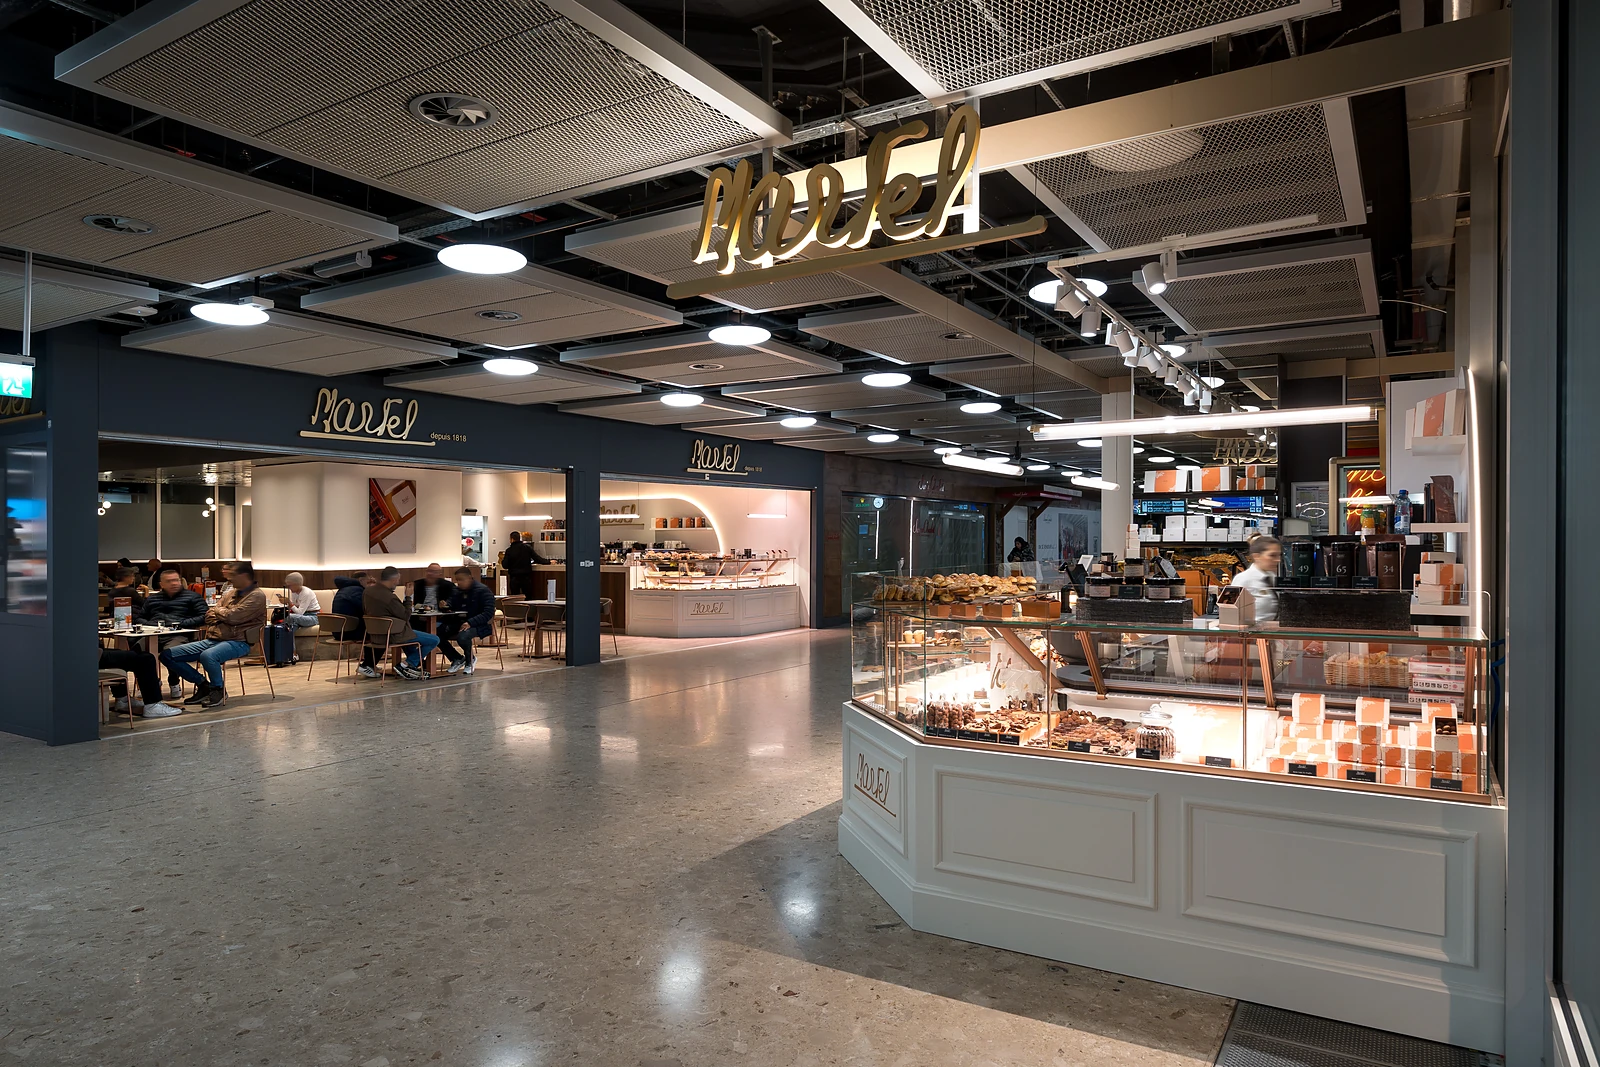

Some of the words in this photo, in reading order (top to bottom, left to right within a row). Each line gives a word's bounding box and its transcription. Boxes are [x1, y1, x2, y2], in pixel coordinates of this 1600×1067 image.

[691, 104, 982, 275] Martel
[311, 387, 419, 440] Martel
[430, 431, 451, 442] depuis
[452, 433, 467, 443] 1818
[691, 439, 741, 472] Martel
[1298, 564, 1309, 573] 49
[1336, 564, 1347, 574] 65
[1383, 564, 1394, 574] 34
[692, 601, 724, 614] Martel
[856, 752, 890, 806] Martel
